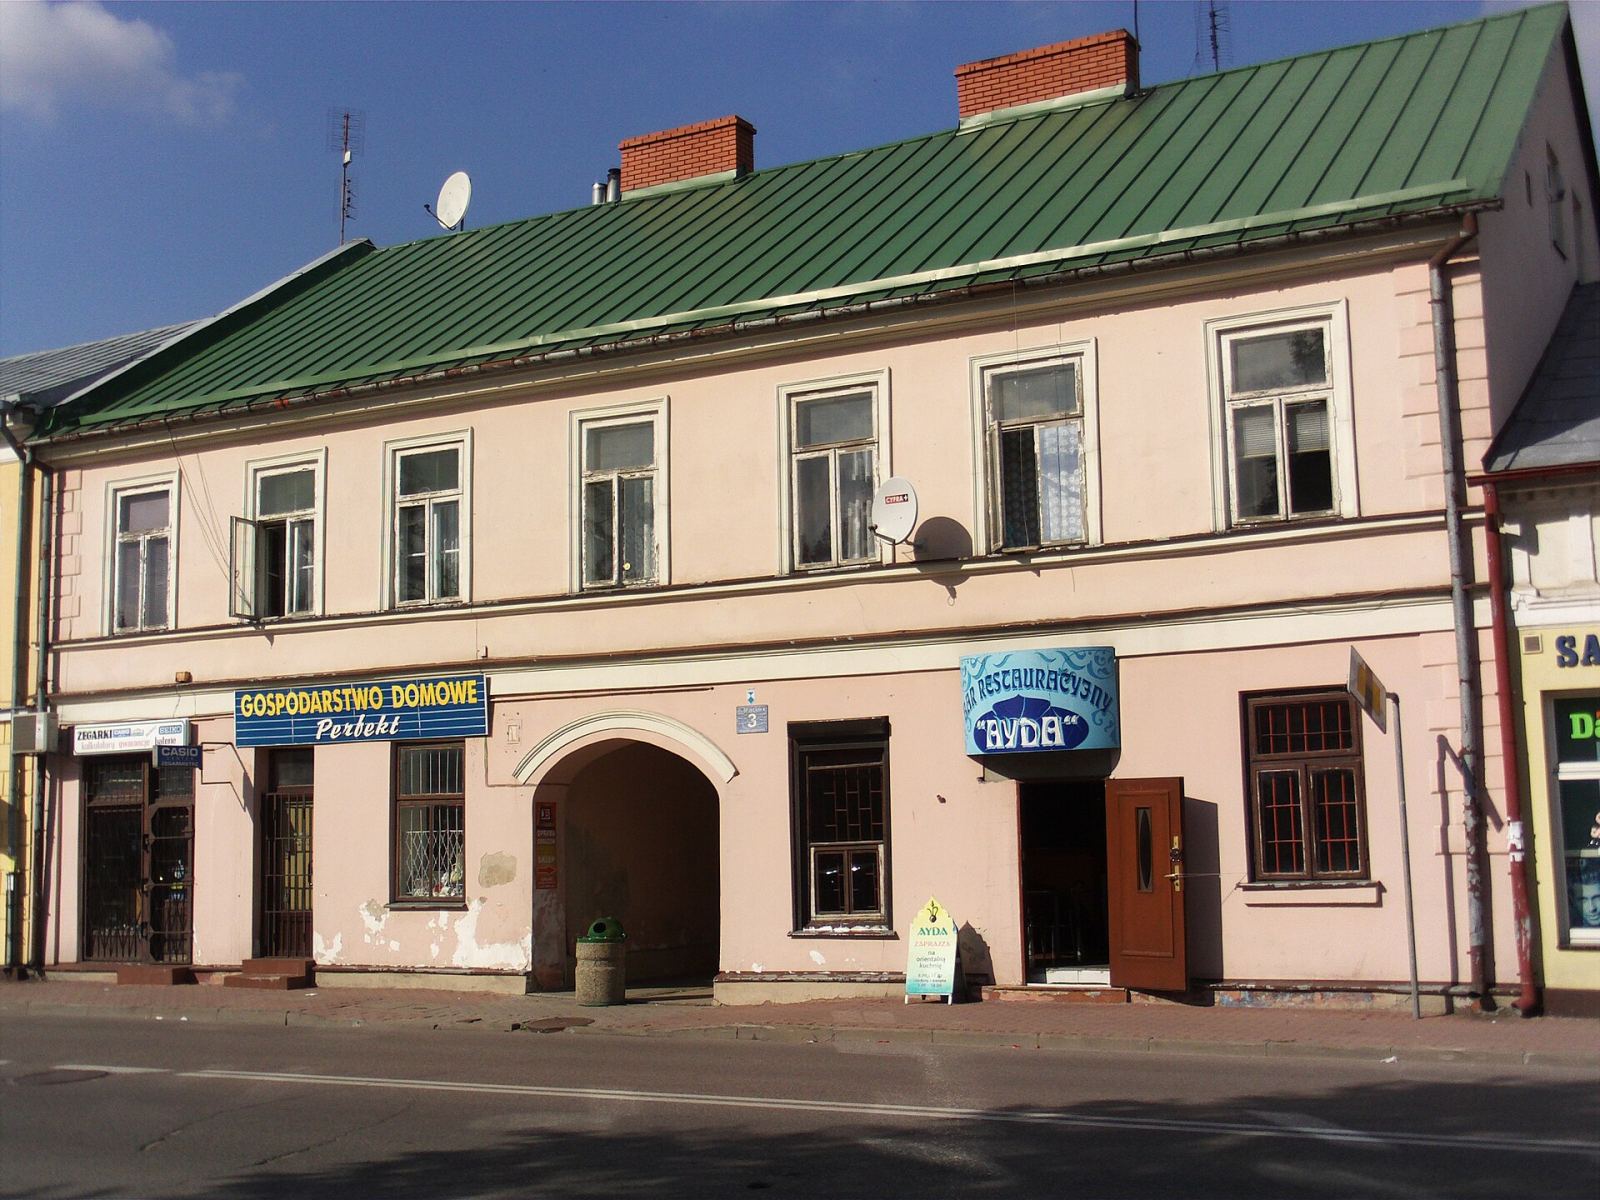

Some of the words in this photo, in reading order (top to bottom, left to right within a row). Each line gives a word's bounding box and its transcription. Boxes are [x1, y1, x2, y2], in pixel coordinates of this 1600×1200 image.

[240, 685, 383, 717] GOSPODARSTWO
[391, 679, 478, 708] DOMOWE
[747, 713, 757, 728] 3
[159, 725, 182, 734] SEIKO
[316, 714, 401, 740] Perfekt
[77, 729, 112, 741] ZEGARKI
[161, 747, 198, 757] CASIO
[918, 927, 948, 935] AYDA
